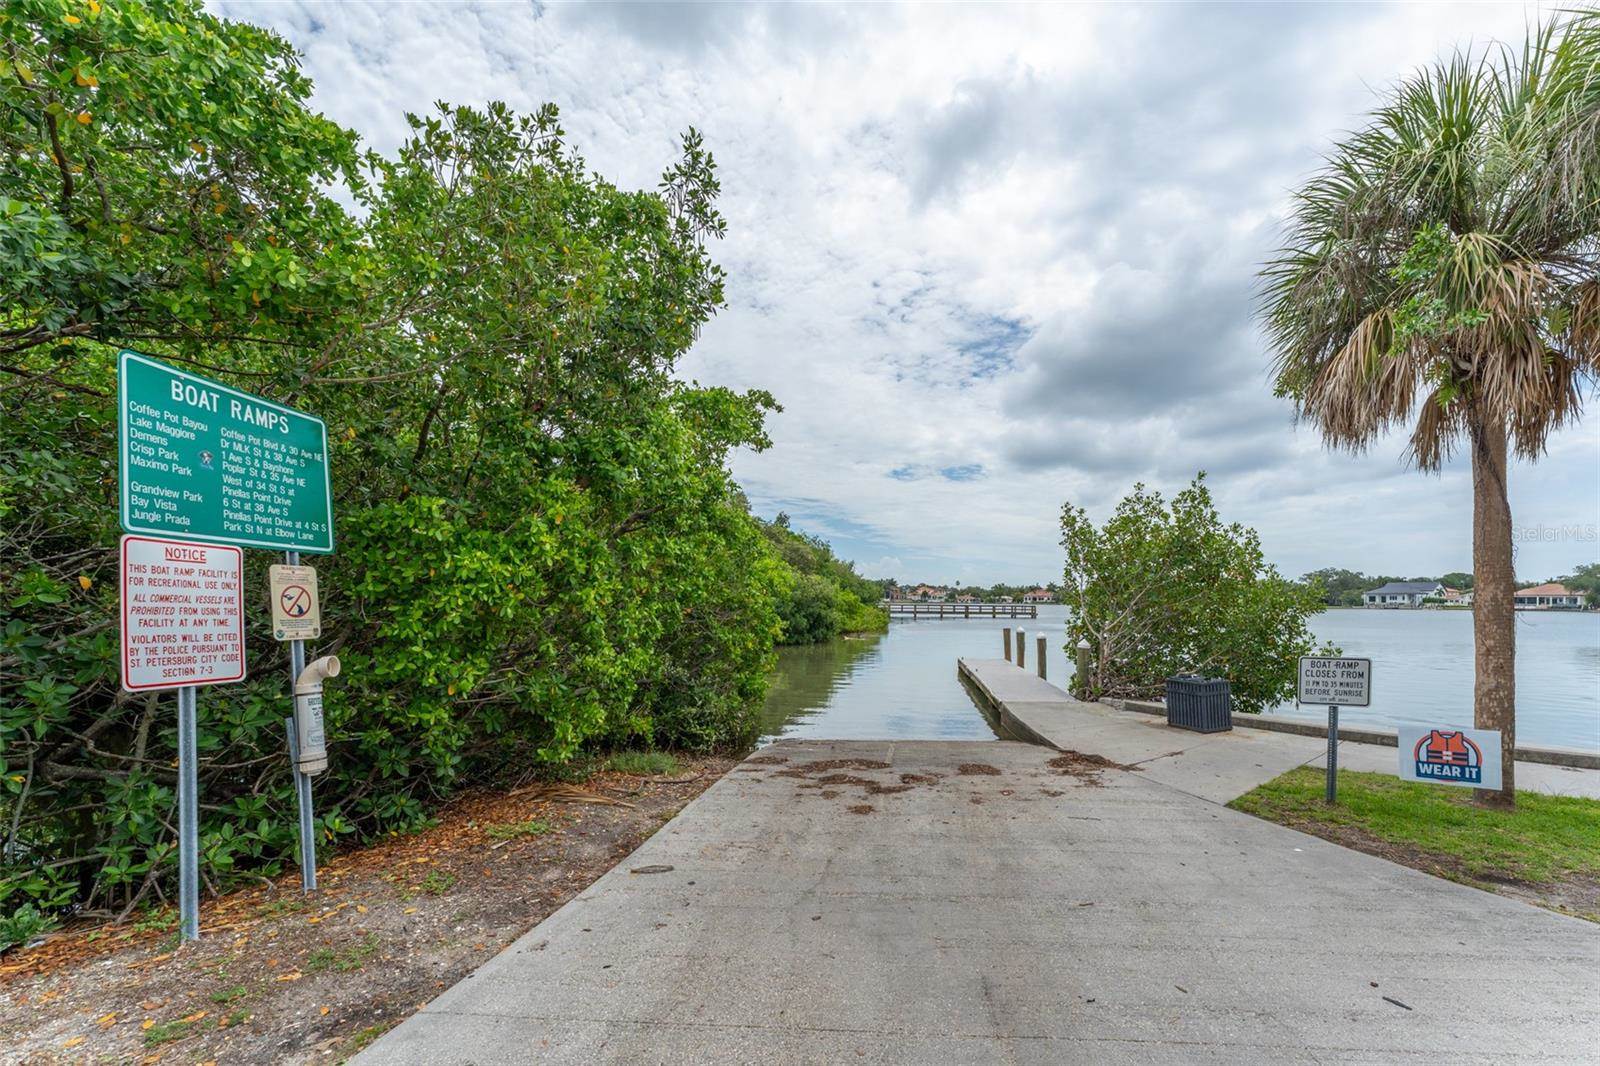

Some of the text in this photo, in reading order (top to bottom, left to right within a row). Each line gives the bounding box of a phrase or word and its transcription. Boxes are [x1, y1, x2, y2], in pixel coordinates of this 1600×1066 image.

[171, 380, 289, 433] BOAT RAMPS
[129, 401, 208, 431] Coffee Pot Bayou
[130, 414, 195, 440] Lake Maggiore
[130, 428, 168, 447] Demens
[221, 427, 323, 462] Coffee Pot Blvd & 30 Ave NE
[130, 441, 179, 461] Crisp Park
[221, 439, 230, 448] Dr
[233, 442, 250, 454] MLK
[253, 447, 261, 457] St
[265, 450, 270, 459] &
[273, 452, 282, 462] 38
[286, 456, 298, 466] Ave
[130, 455, 192, 476] Maximo Park
[222, 451, 294, 475] 1 Ave S & Bayshore
[223, 461, 306, 487] Poplar St & 35 Ave NE
[131, 481, 203, 503] Grandview Park
[222, 474, 295, 496] West of 34 St S at
[131, 495, 177, 511] Bay Vista
[223, 486, 292, 506] Pinellas Point Drive
[223, 498, 288, 516] 6 St at 38 Ave S
[132, 509, 190, 525] Jungle Prada
[223, 510, 252, 522] Pinellas
[254, 514, 272, 525] Point
[275, 517, 293, 528] Drive
[295, 521, 301, 529] at
[311, 522, 319, 531] St
[321, 524, 327, 532] S
[224, 521, 314, 540] Park St N at Elbow Lane
[165, 547, 206, 560] NOTICE
[129, 564, 237, 579] THIS BOAT RAMP FACILITY IS
[129, 577, 144, 585] FOR
[148, 578, 201, 589] RECREATIONAL
[133, 594, 235, 604] ALL COMMERCIAL VESSELS ARE
[131, 606, 237, 616] PROHIBITED FROM USING THIS
[139, 619, 175, 627] FACILITY
[179, 619, 188, 627] AT
[193, 619, 208, 627] ANY
[131, 633, 237, 644] VIOLATORS WILL BE CITED
[129, 644, 239, 656] BY THE POLICE PURSUANT TO
[146, 656, 197, 666] PETERSBURG
[201, 655, 217, 663] CITY
[221, 654, 240, 662] CODE
[1335, 661, 1359, 669] RAMP
[162, 666, 213, 678] SECTION 7-3
[1305, 670, 1364, 679] CLOSES FROM
[1418, 762, 1478, 779] WEAR IT
